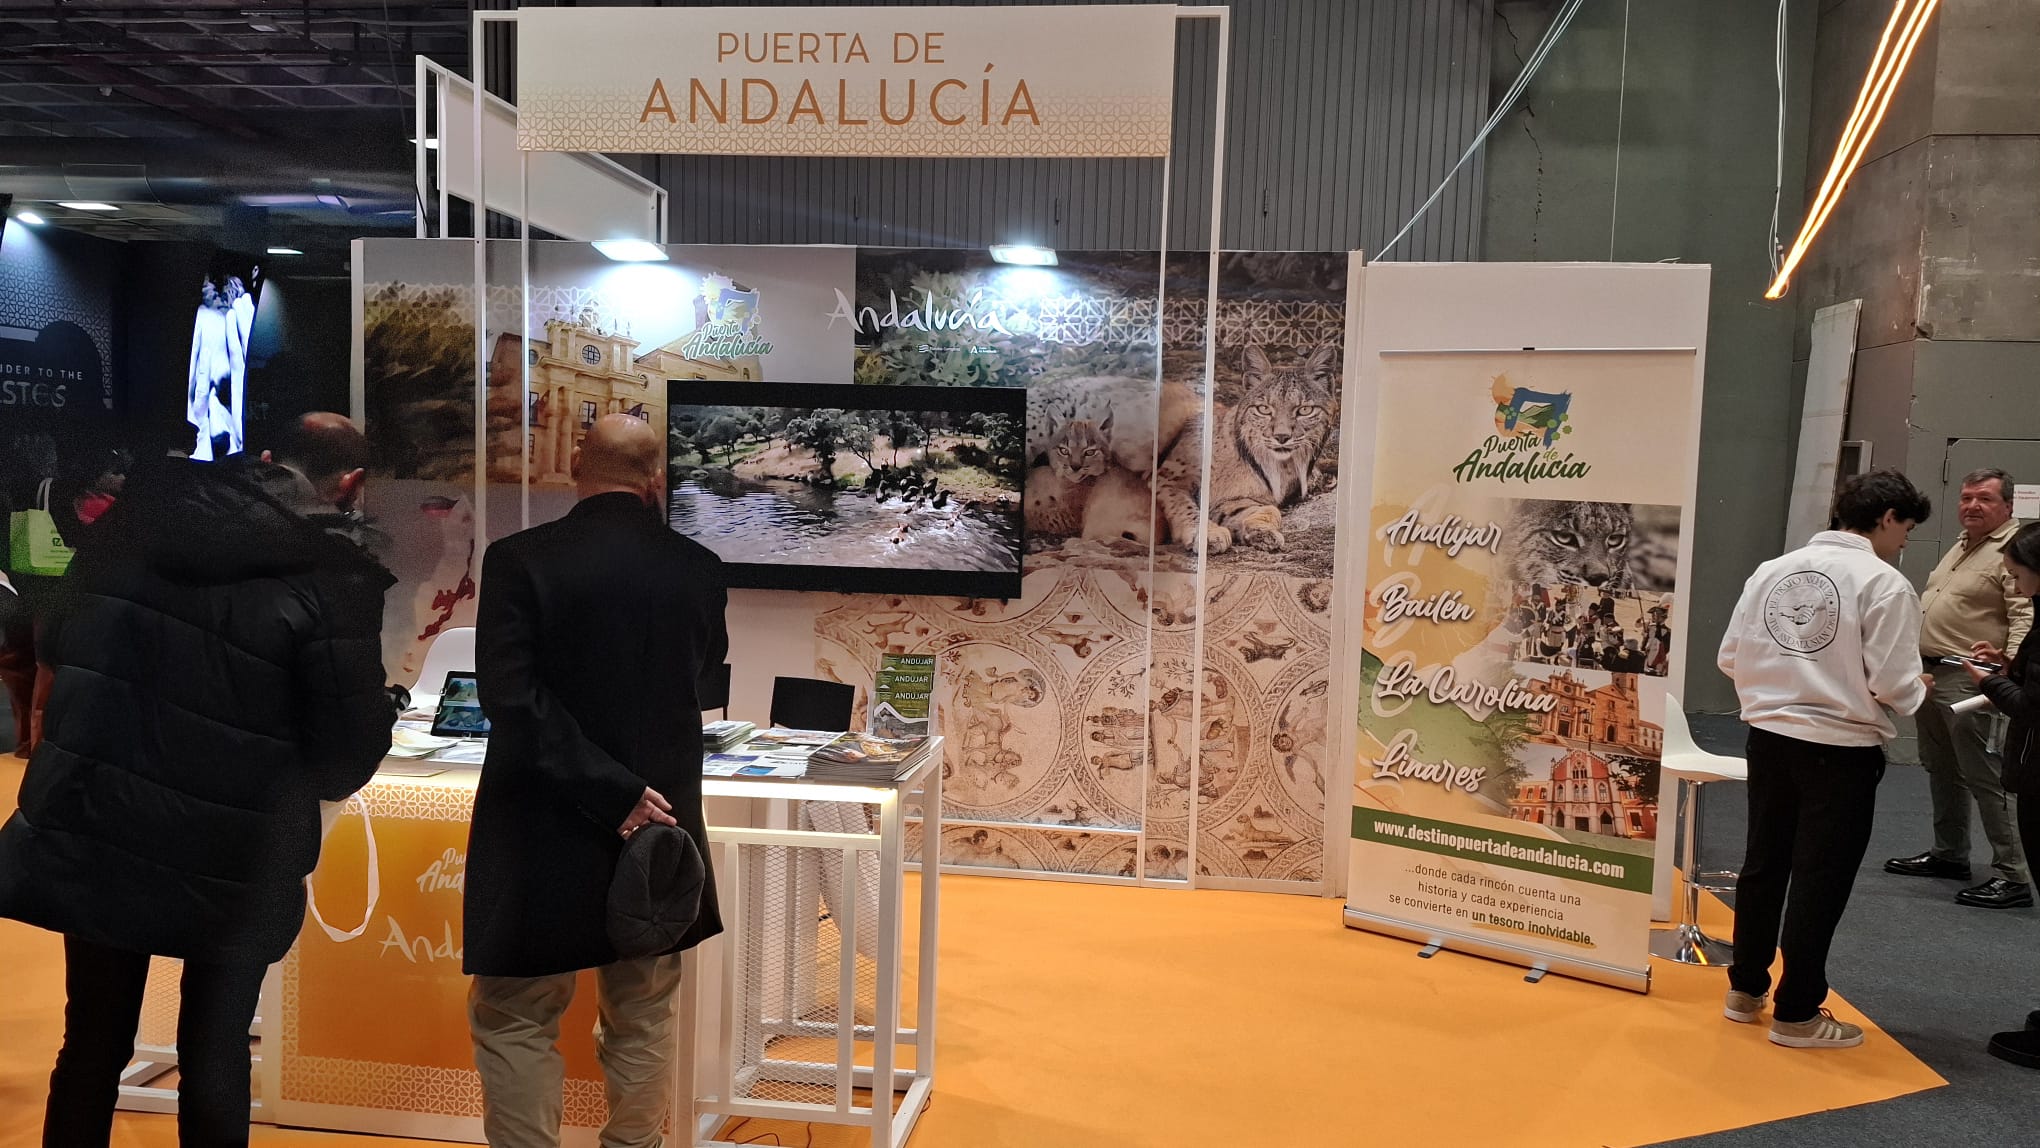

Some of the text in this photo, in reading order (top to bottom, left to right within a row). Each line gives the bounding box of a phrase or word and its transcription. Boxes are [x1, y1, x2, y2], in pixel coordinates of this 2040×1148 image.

[717, 32, 945, 64] PUERTA DE
[639, 63, 1041, 127] ANDALUCÍA
[825, 287, 1014, 335] Andalucía
[683, 333, 774, 359] Andalucía
[703, 321, 740, 340] Puerta
[38, 367, 53, 378] TO
[60, 369, 83, 380] THE
[0, 380, 66, 407] STES
[1483, 431, 1558, 462] Puerta de
[1453, 448, 1592, 484] Andalucía
[1386, 509, 1502, 557] Andújar
[1382, 583, 1476, 625] Bailén
[900, 657, 934, 665] ANDUJAR
[894, 675, 929, 683] ANDUJAR
[895, 692, 929, 700] ANDUJAR
[1377, 661, 1559, 712] La Carolina
[1372, 742, 1487, 792] Linares
[443, 848, 466, 870] Pu
[1374, 820, 1625, 880] www.destinopuertadeandalucia.com
[416, 860, 464, 895] And
[1451, 872, 1476, 885] cada
[1479, 877, 1514, 893] rincón
[1518, 885, 1556, 901] cuenta
[1560, 894, 1582, 906] una
[1418, 881, 1564, 921] historia y cada experiencia
[1388, 894, 1595, 946] se convierte en un tesoro inolvidable.
[378, 915, 463, 963] And
